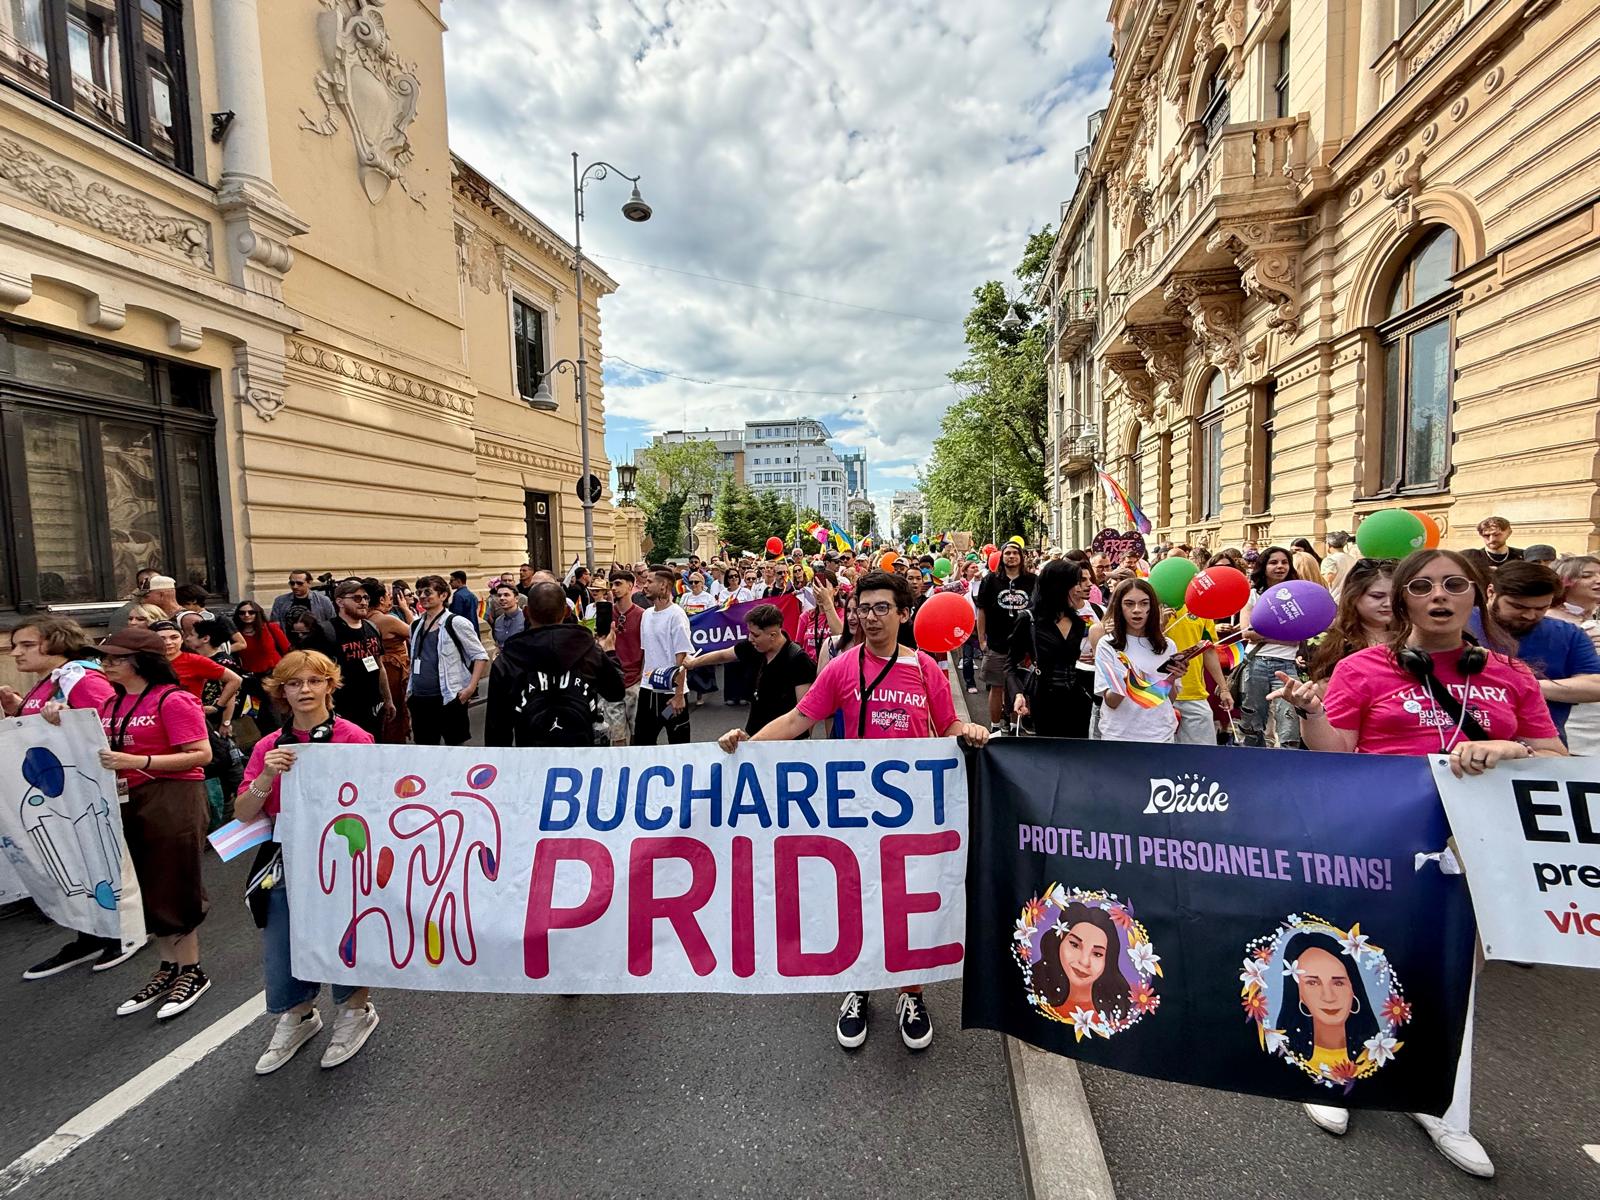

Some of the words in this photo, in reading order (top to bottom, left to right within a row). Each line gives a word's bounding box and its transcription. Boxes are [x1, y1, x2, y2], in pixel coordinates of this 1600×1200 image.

[1103, 539, 1135, 552] FREE
[692, 625, 748, 644] QUAL
[854, 688, 927, 708] VLUNTARX
[871, 711, 910, 721] BUCHAREST
[871, 718, 891, 726] PRIDE
[894, 720, 909, 728] 2026
[538, 757, 960, 832] BUCHAREST
[1142, 778, 1229, 814] Pride
[1511, 779, 1600, 844] ED
[1138, 836, 1292, 881] PERSOANELE
[1297, 851, 1393, 891] TRANS!
[1532, 862, 1600, 892] pre
[523, 830, 965, 980] PRIDE
